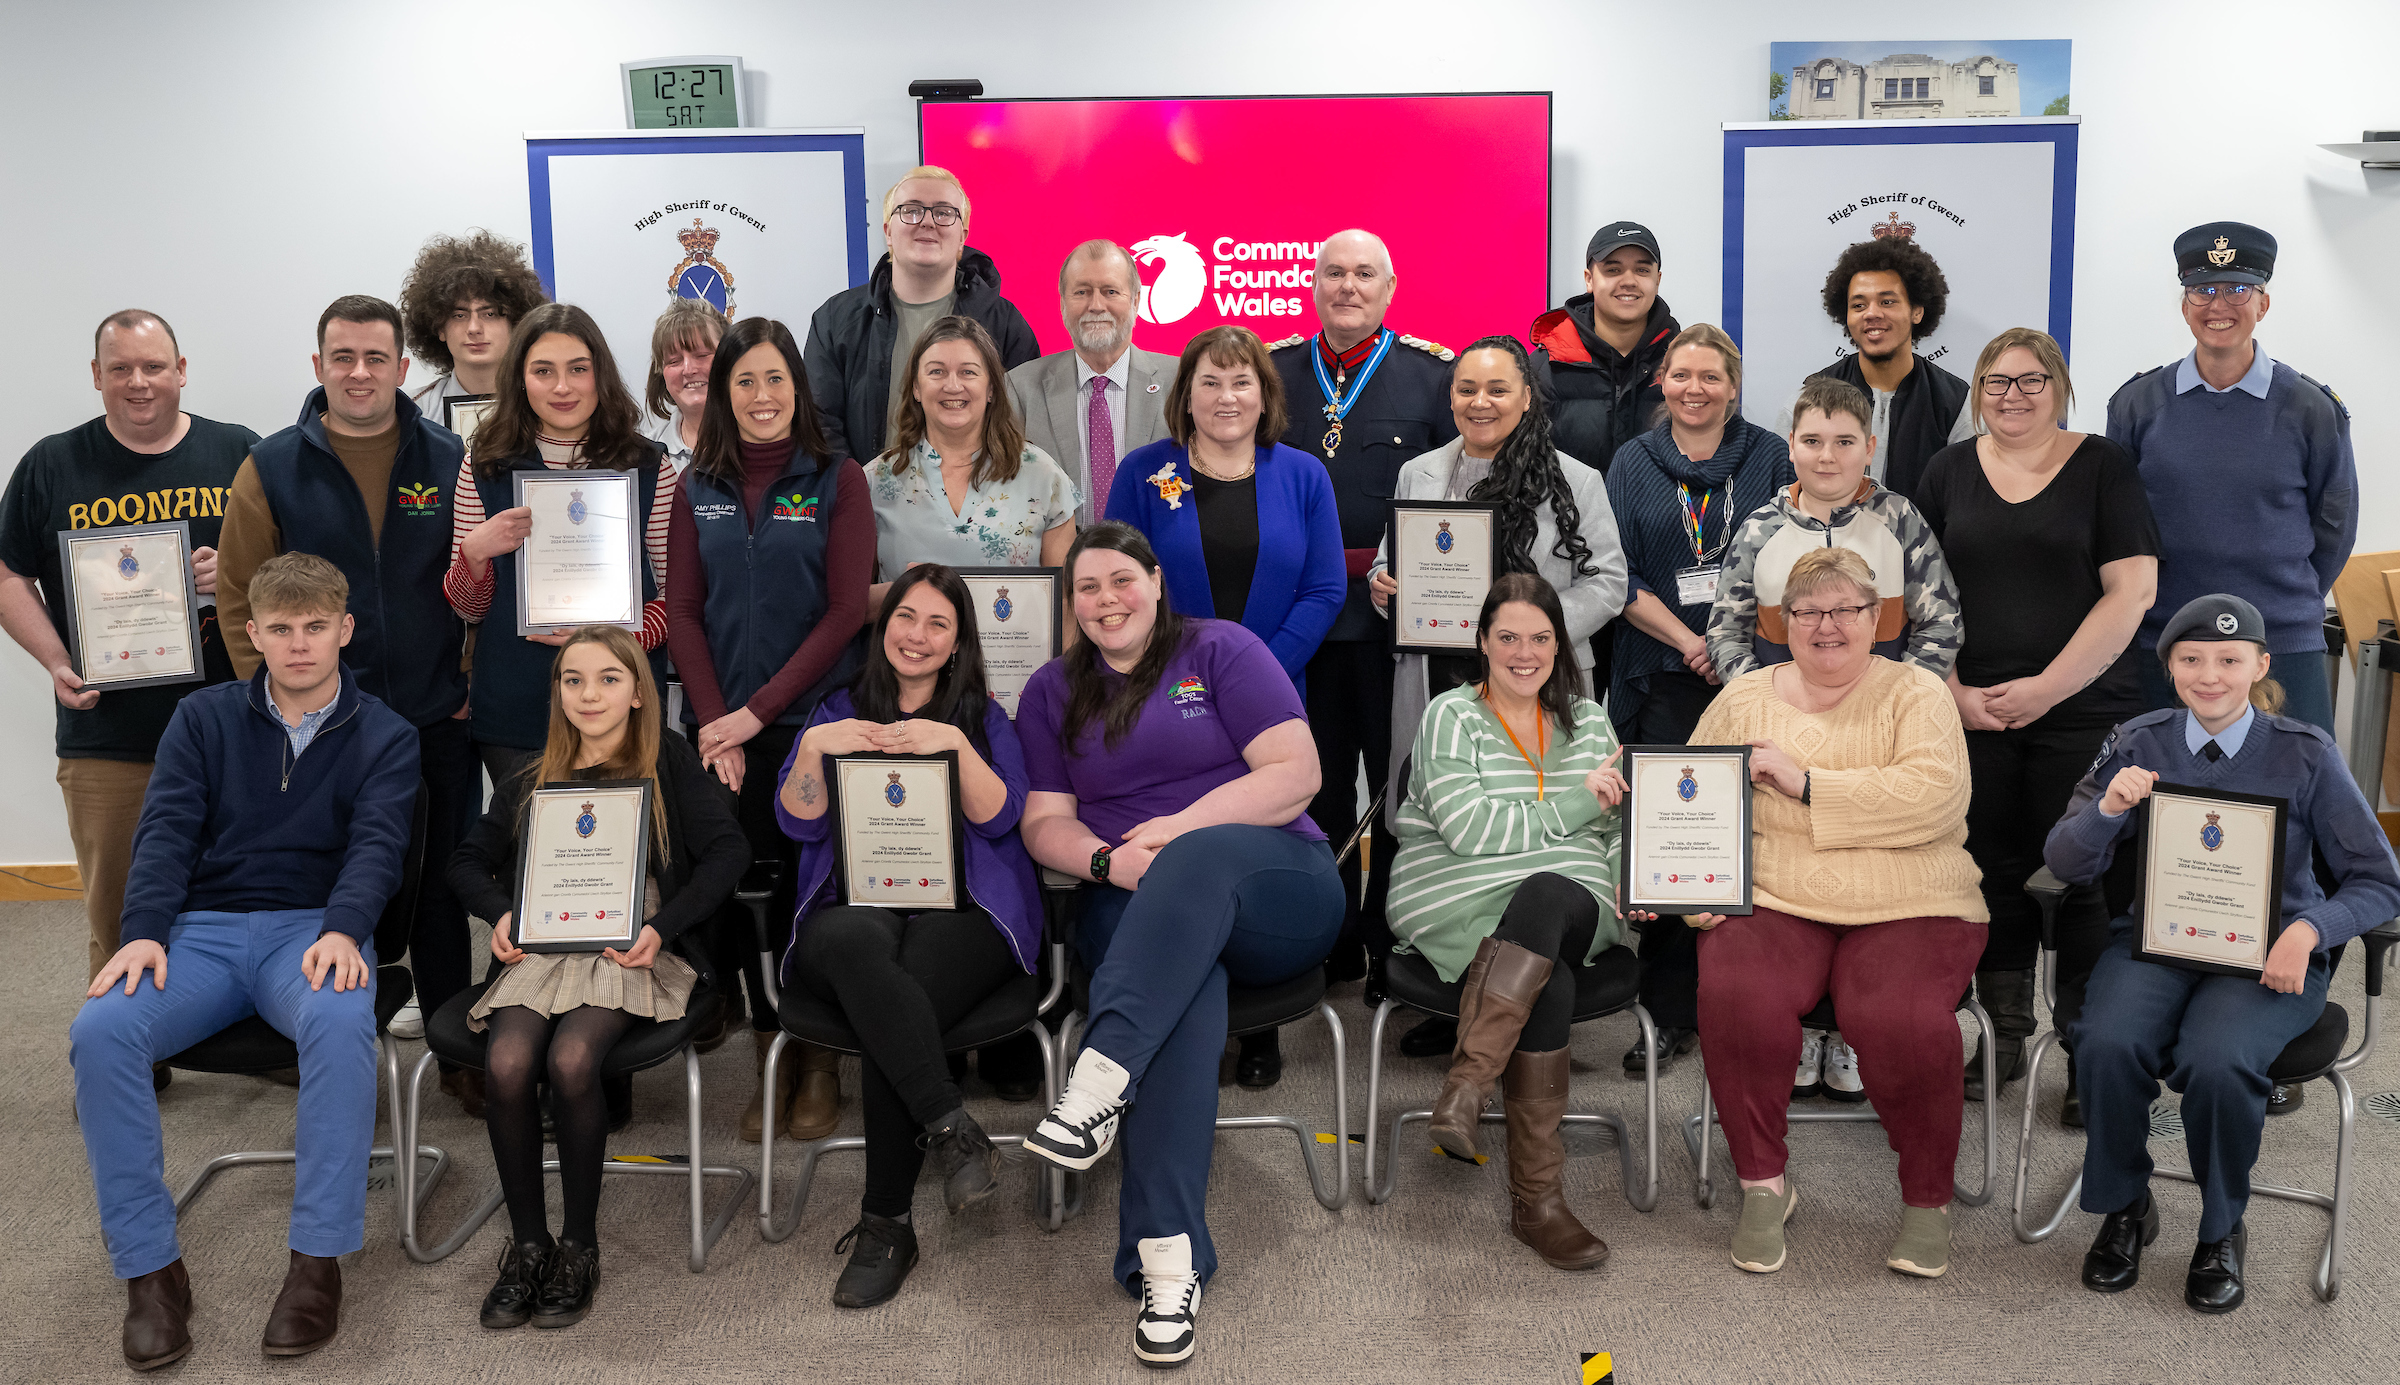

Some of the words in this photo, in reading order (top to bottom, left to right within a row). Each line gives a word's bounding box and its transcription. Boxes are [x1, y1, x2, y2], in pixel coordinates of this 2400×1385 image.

[655, 70, 723, 99] 12:27
[666, 105, 705, 126] SAT
[634, 211, 663, 232] High
[665, 200, 711, 214] Sheriff
[713, 203, 727, 212] of
[729, 206, 767, 233] Gwent
[1827, 203, 1858, 225] High
[1860, 193, 1908, 208] Sheriff
[1911, 196, 1927, 206] of
[1927, 200, 1966, 227] Gwent
[1213, 237, 1323, 261] Commu
[1213, 264, 1315, 289] Founda
[1213, 292, 1303, 316] Wales
[1924, 345, 1950, 362] ent
[68, 487, 232, 530] BOONAN
[399, 495, 439, 504] GWENT
[774, 506, 817, 516] GWENT
